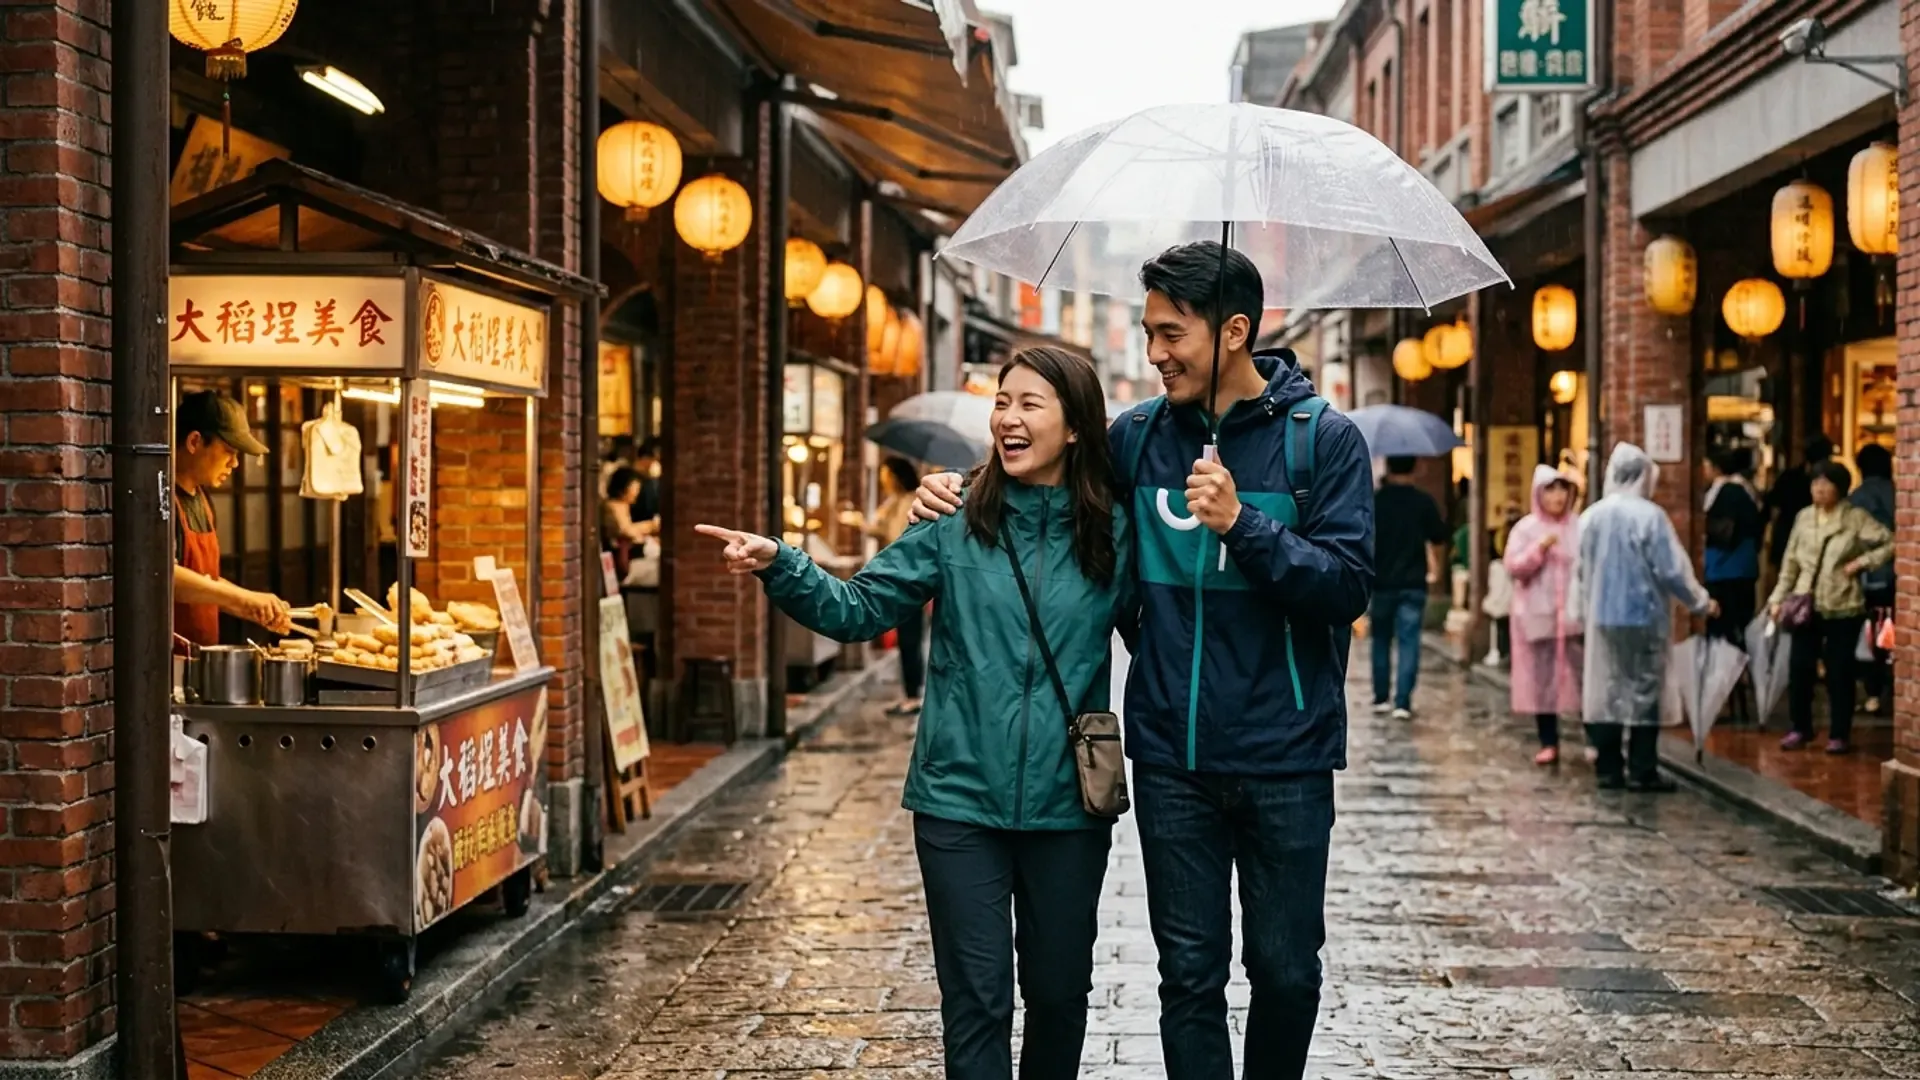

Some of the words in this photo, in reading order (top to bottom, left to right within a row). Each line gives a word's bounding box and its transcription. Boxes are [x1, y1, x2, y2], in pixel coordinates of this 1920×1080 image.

[171, 298, 394, 347] 大稻埕美食
[438, 717, 528, 811] 大稻埕美食
